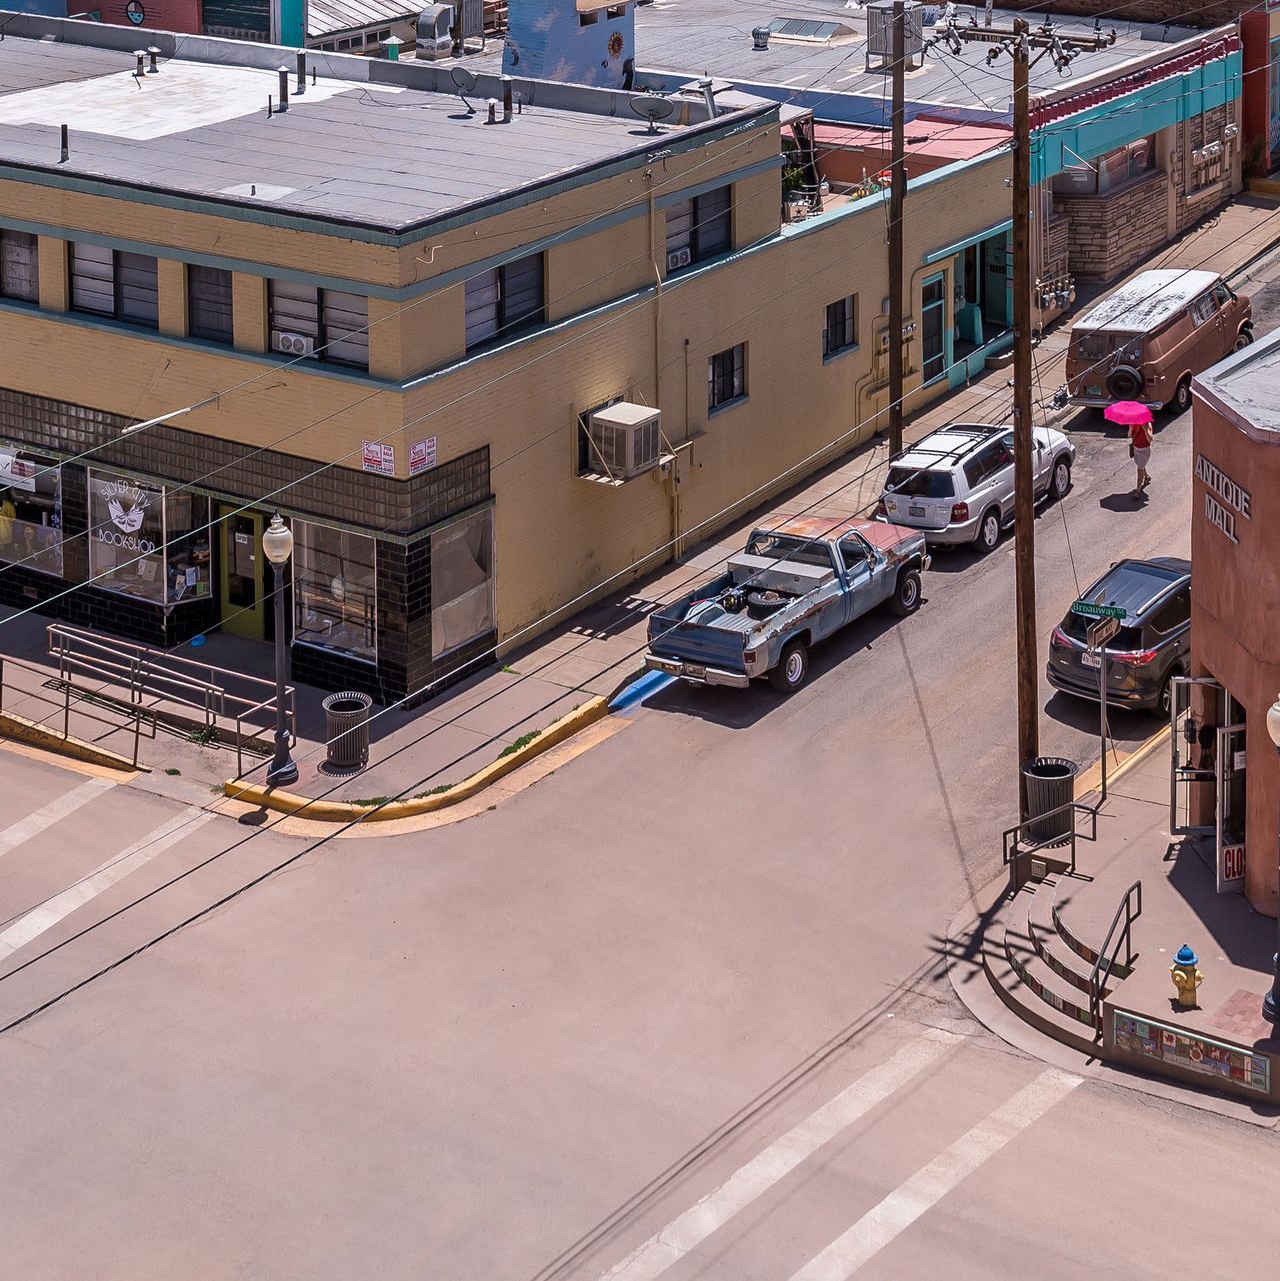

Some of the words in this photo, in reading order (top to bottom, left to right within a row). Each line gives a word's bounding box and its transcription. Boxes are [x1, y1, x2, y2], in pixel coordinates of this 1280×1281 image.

[101, 479, 129, 501] SILVER
[1194, 454, 1251, 520] ANTIQUE
[1205, 492, 1239, 545] MALL
[1073, 602, 1116, 617] Broadway
